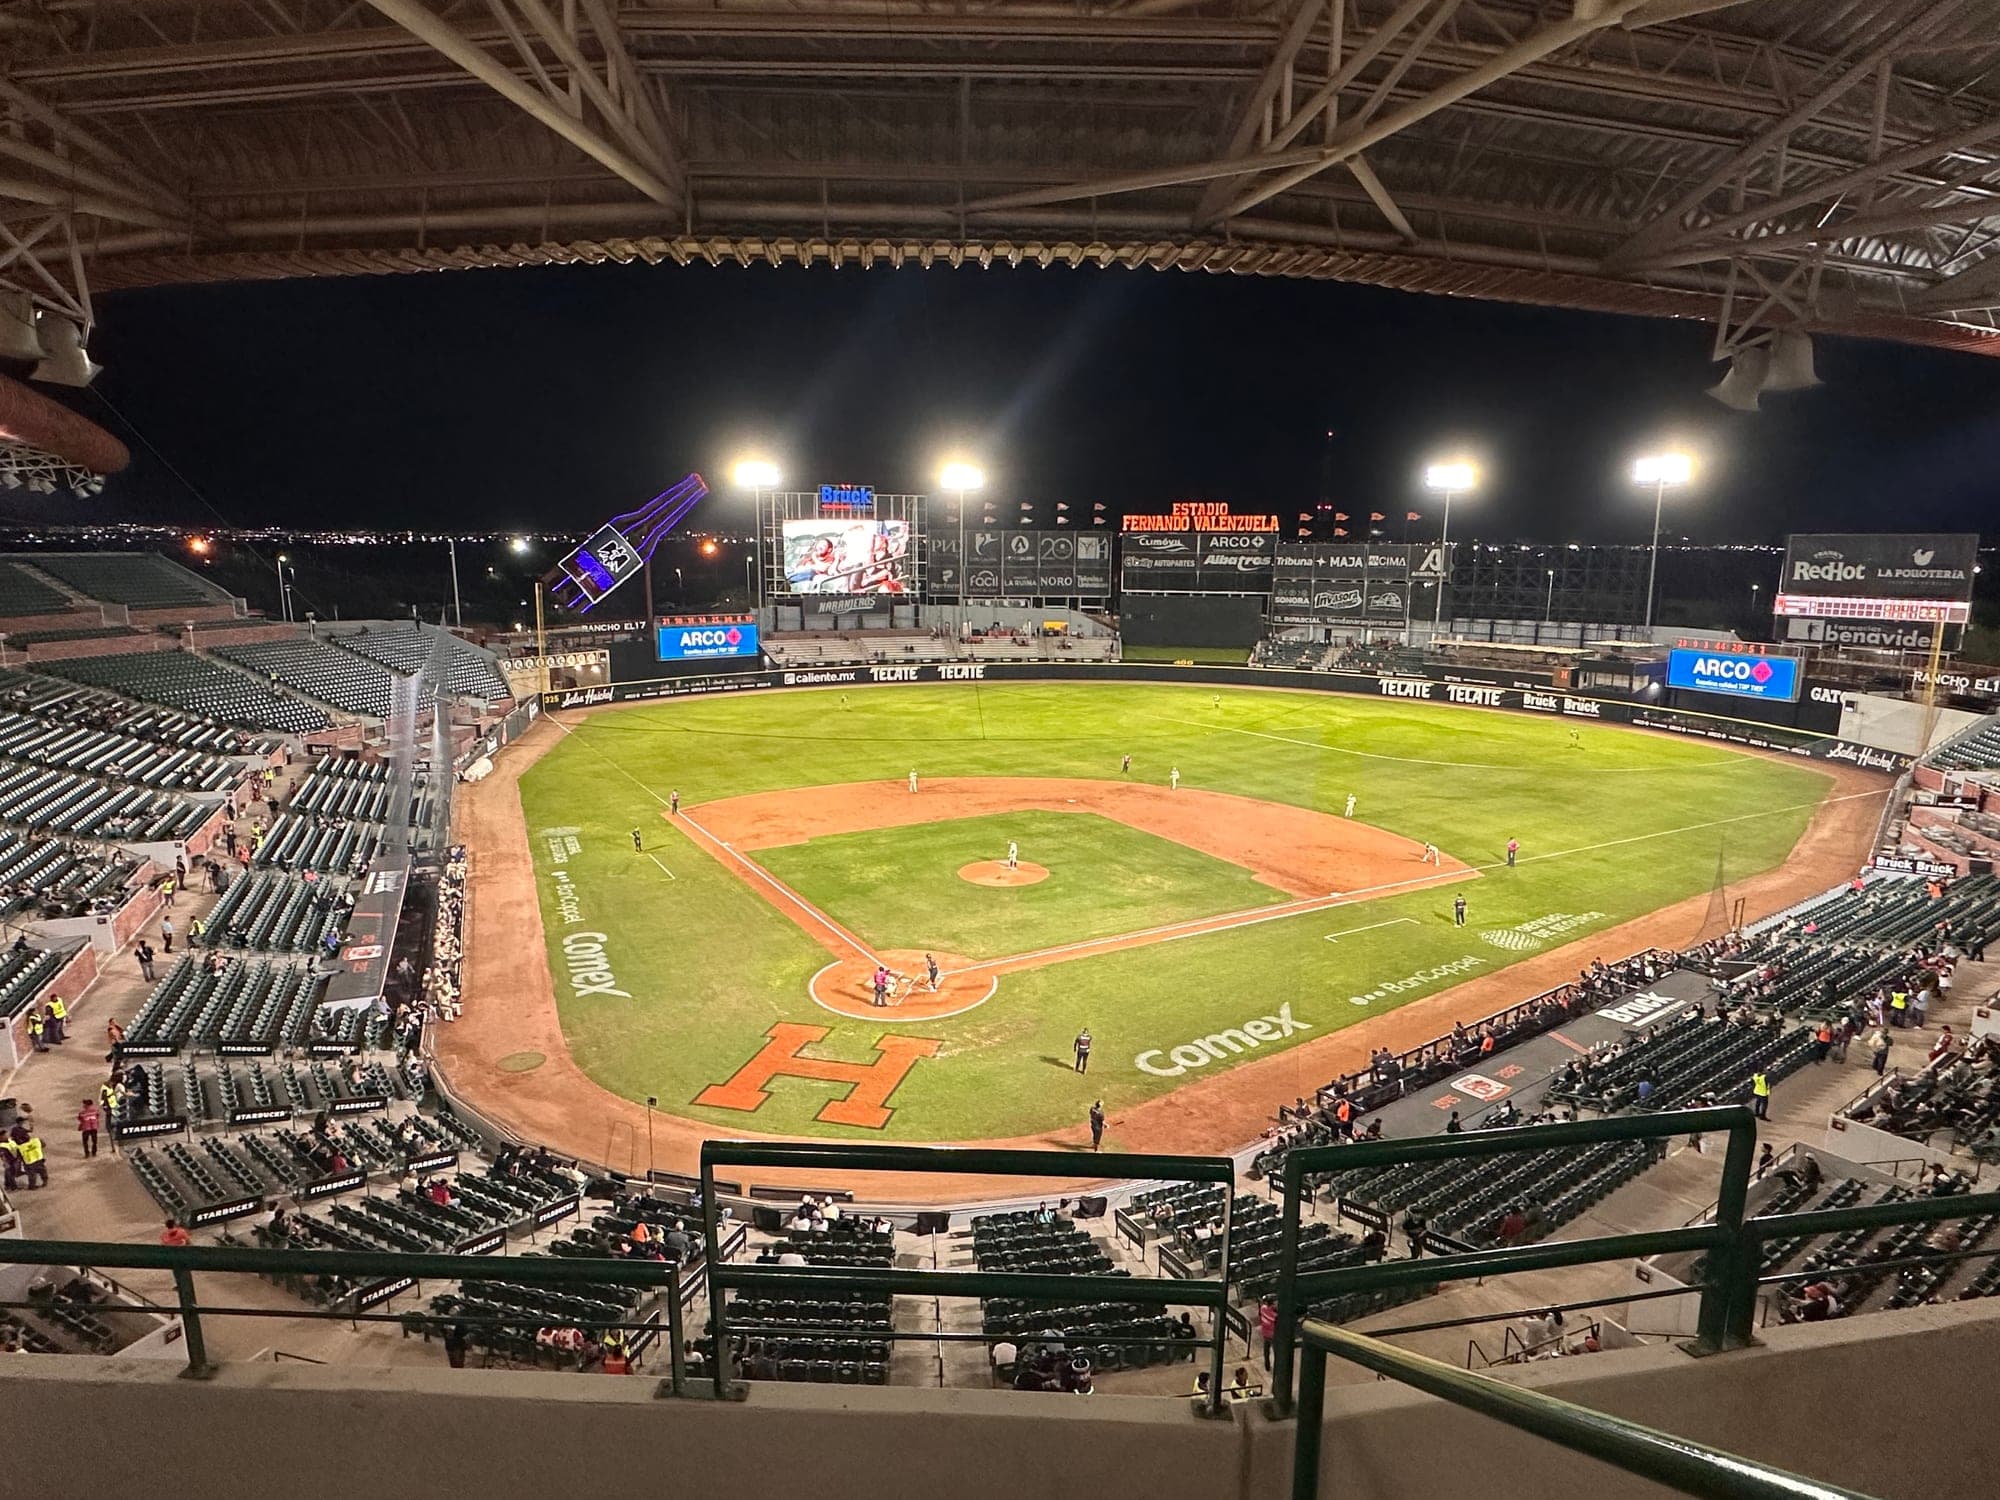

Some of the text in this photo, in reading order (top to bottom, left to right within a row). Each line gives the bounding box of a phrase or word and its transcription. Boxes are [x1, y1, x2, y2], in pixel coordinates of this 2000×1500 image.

[821, 484, 872, 504] Brück
[1172, 502, 1229, 516] ESTADIO
[1122, 515, 1280, 531] FERNANDO VALENZUELA
[1209, 536, 1250, 547] ARCO
[1153, 559, 1196, 568] AUTOPARTES
[1276, 556, 1313, 567] Tribuna
[1329, 556, 1363, 568] MAJA
[1792, 560, 1866, 581] RedHot
[1877, 568, 1894, 578] LA
[1040, 576, 1073, 586] NORO
[1274, 596, 1310, 605] SONORA
[624, 621, 646, 631] EL17
[680, 630, 725, 646] ARCO
[870, 667, 920, 681] TECATE
[937, 665, 987, 679] TECATE
[1693, 658, 1750, 679] ARCO
[795, 672, 855, 683] caliente.mx
[1913, 670, 1969, 688] RANCHO
[1378, 679, 1435, 698] TECATE
[1446, 684, 1506, 706] TECATE
[1379, 954, 1487, 994] BanCoppel
[221, 1045, 267, 1053] STARBUCKS
[312, 1045, 356, 1053] STARBUCKS
[689, 1020, 945, 1130] H
[334, 1101, 381, 1111] STARBUCKS
[235, 1110, 286, 1121] STARBUCKS
[122, 1123, 178, 1135] STARBUCKS
[408, 1155, 453, 1171] STARBUCKS
[310, 1176, 361, 1194] STARBUCKS
[197, 1201, 256, 1222] STARBUCKS
[538, 1201, 577, 1223] STARBUCKS
[1342, 1204, 1382, 1225] STARBUCKS
[361, 1277, 412, 1305] STARBUCKS
